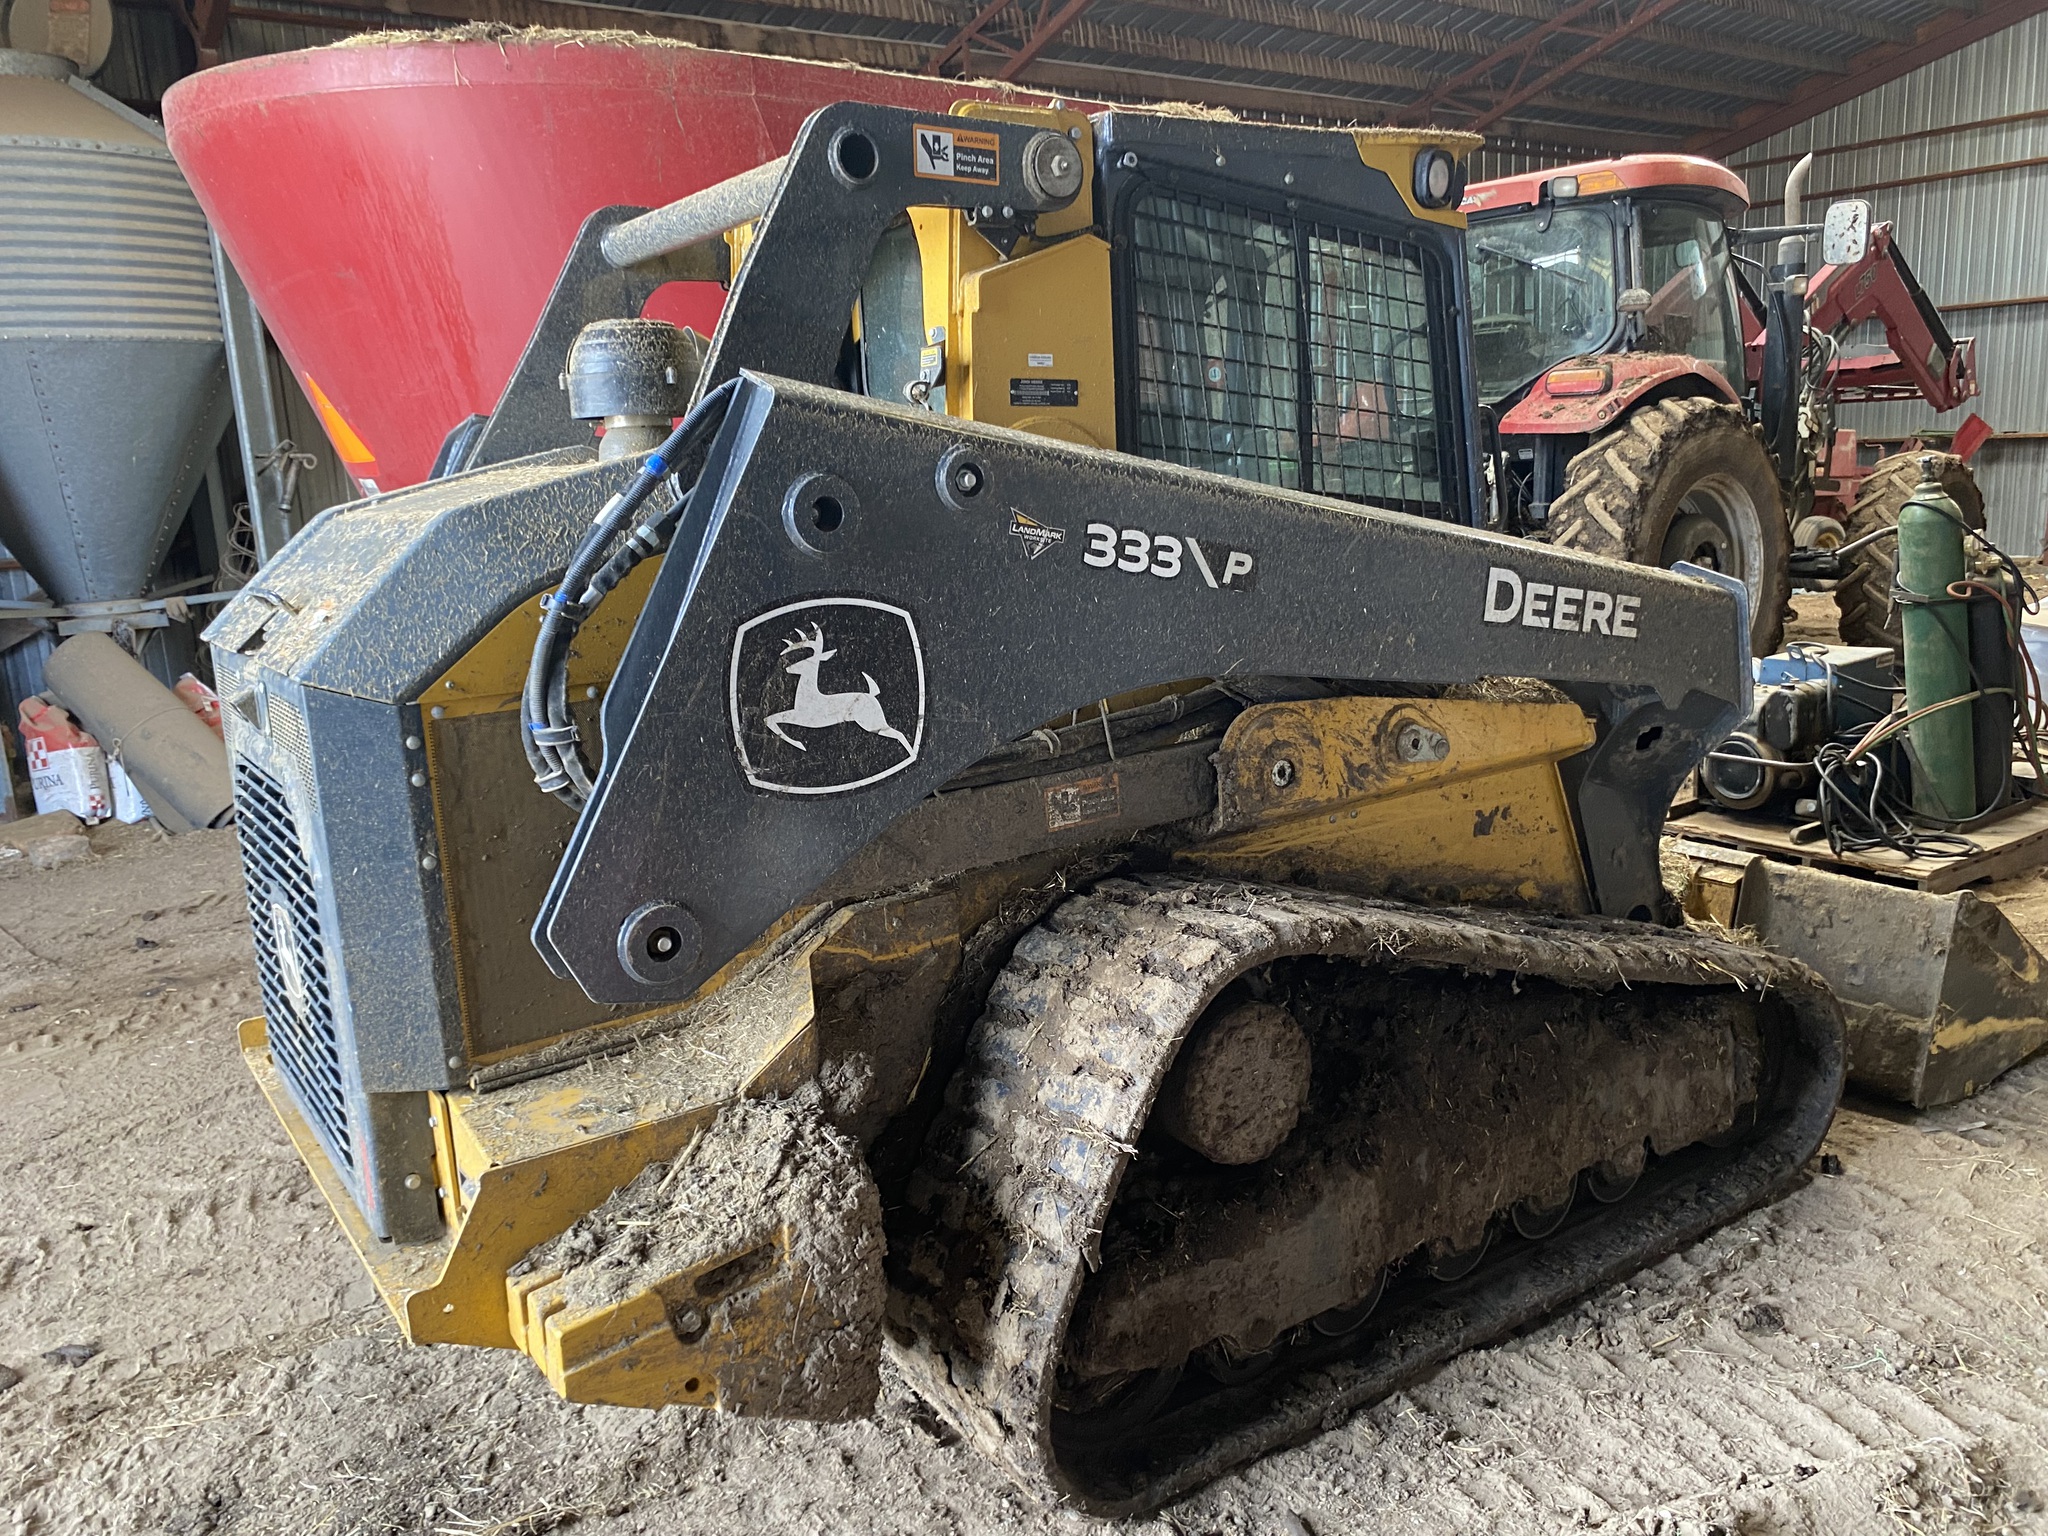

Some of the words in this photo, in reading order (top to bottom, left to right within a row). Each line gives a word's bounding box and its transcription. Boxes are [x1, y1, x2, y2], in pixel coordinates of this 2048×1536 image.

[963, 135, 995, 146] WARNING
[956, 152, 976, 163] Pinch
[977, 155, 994, 165] Area
[956, 164, 972, 173] Keep
[972, 166, 989, 175] Away
[1012, 523, 1063, 540] LANDMARK
[1483, 566, 1642, 638] DEERE
